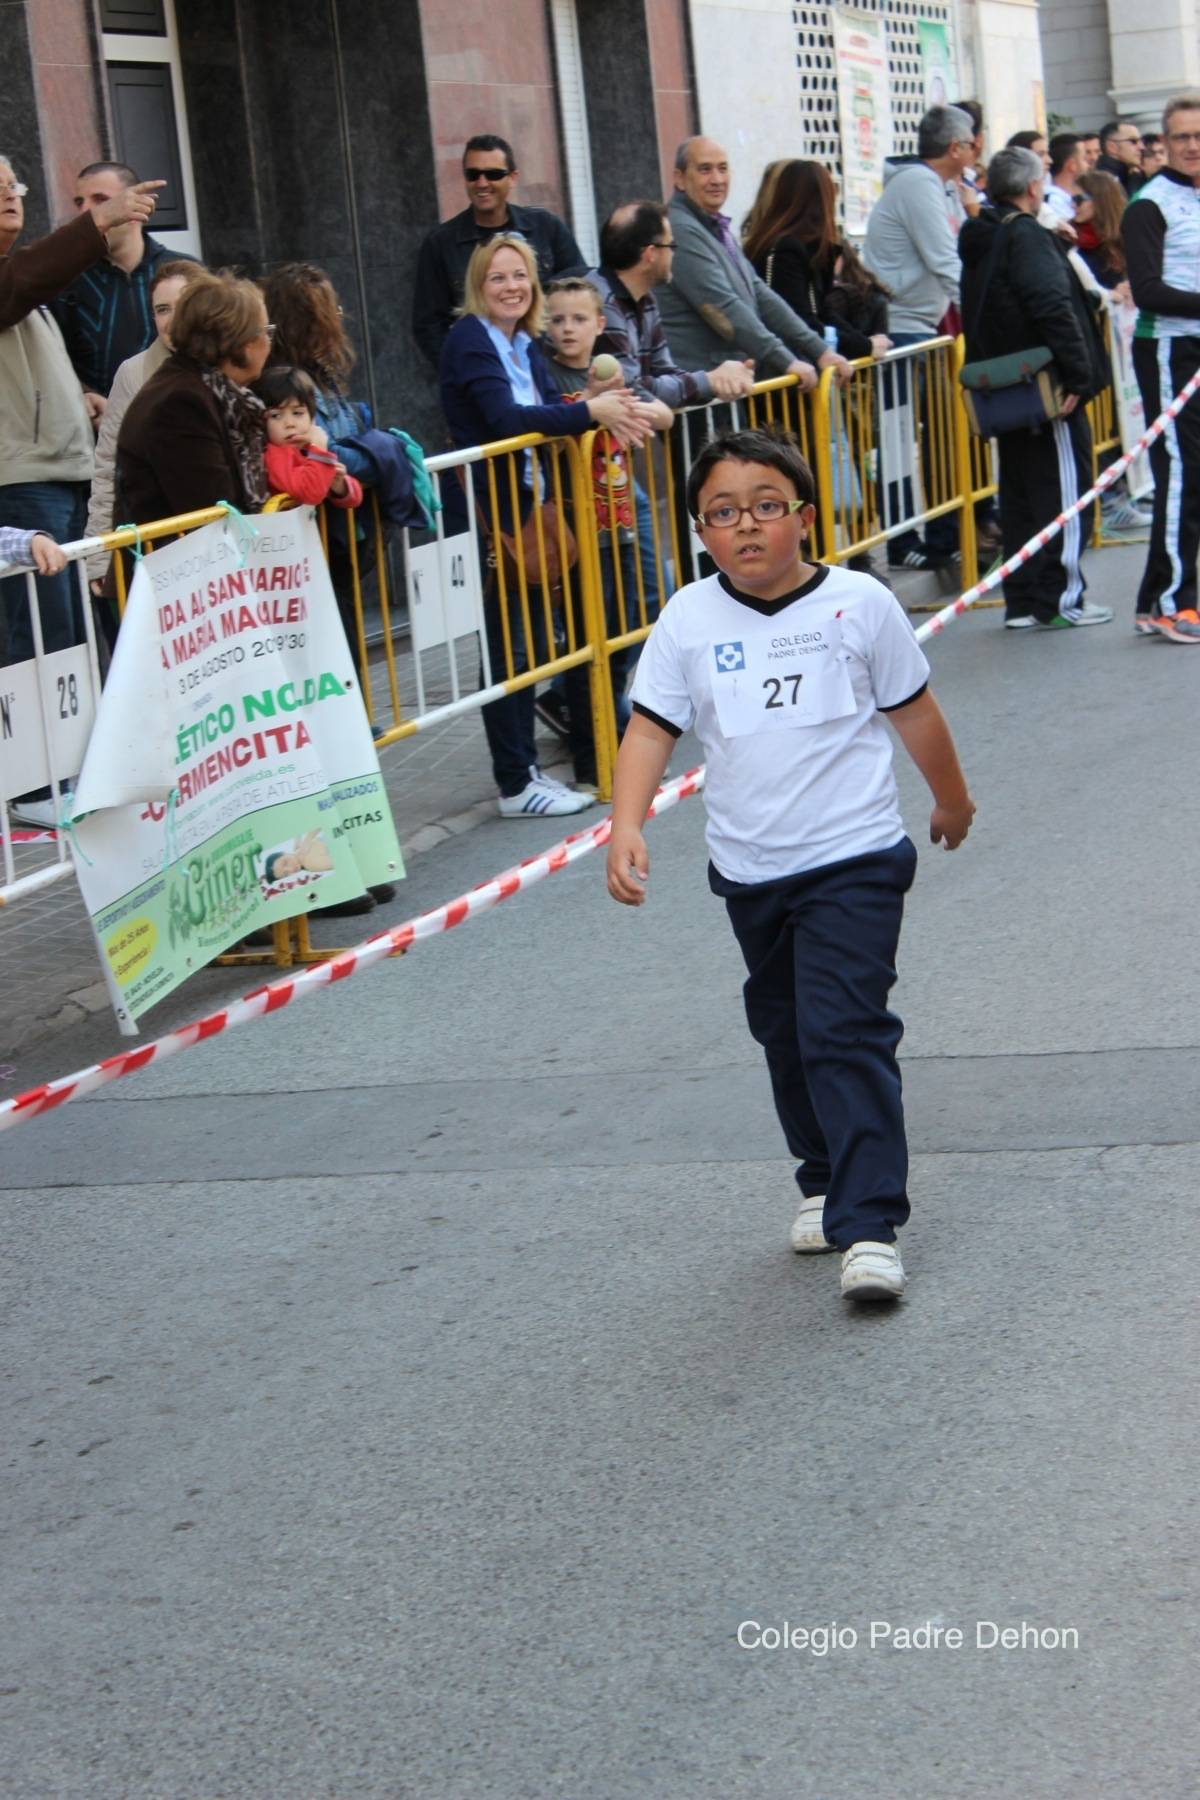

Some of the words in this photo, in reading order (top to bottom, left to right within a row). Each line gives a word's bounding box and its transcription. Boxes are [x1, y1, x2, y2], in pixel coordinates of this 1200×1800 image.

[768, 648, 796, 660] PADRE
[798, 643, 830, 656] DEHON
[771, 631, 823, 649] COLEGIO
[202, 646, 246, 677] AGOSTO
[57, 673, 78, 719] 28
[762, 673, 804, 710] 27
